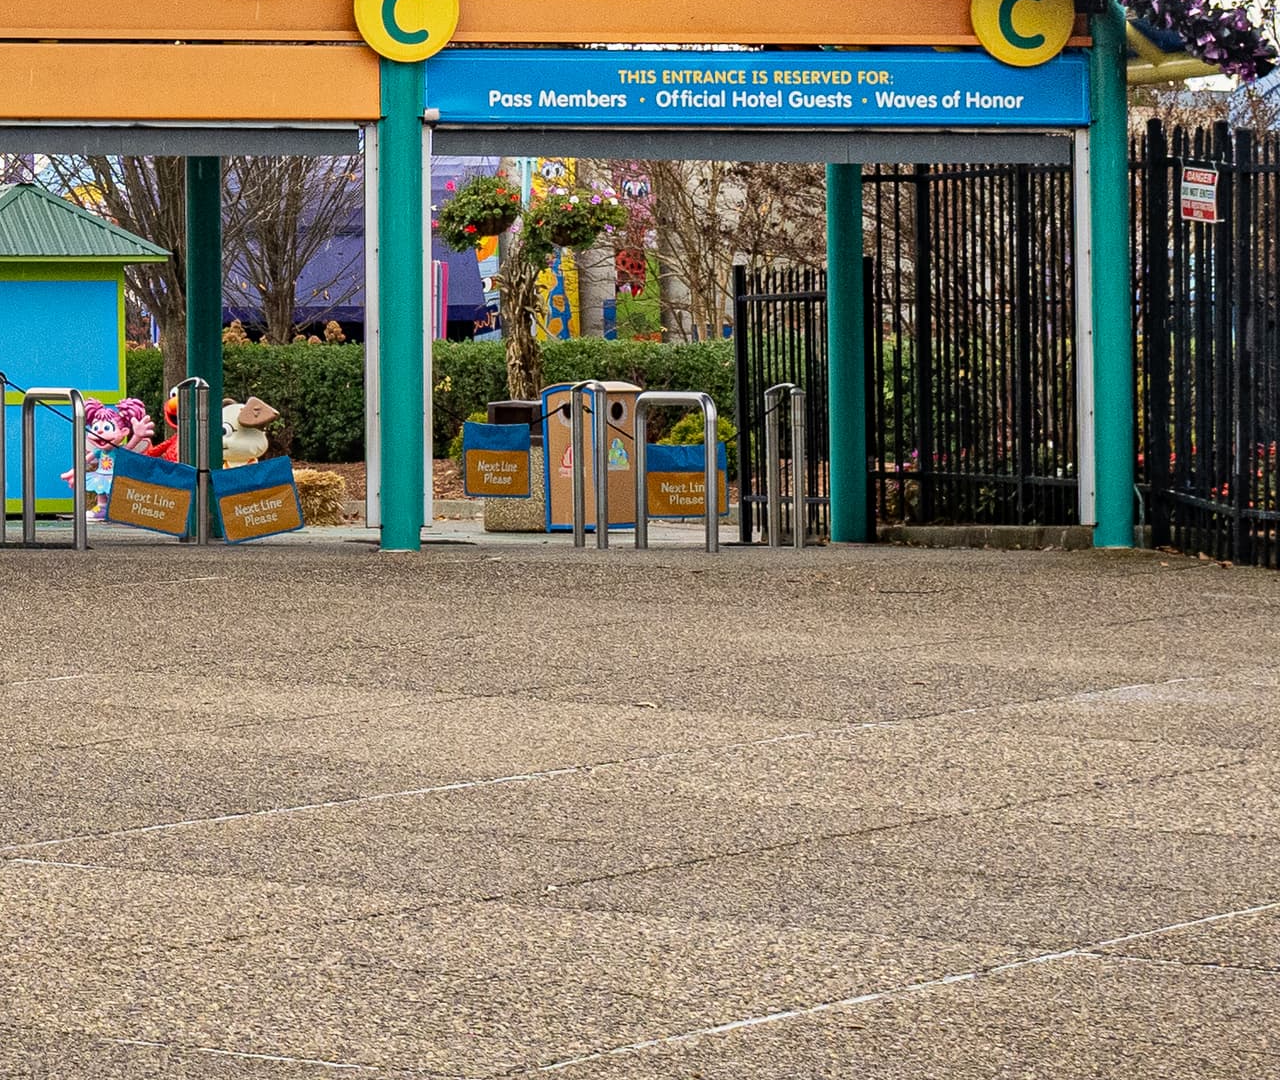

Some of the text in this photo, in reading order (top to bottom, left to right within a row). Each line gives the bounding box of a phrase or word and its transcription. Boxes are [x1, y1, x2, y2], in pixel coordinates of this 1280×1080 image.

[618, 69, 894, 85] THIS ENTRANCE IS RESERVED FOR:
[489, 89, 1024, 109] Pass Members Official Hotel Guests Waves of Honor
[476, 460, 518, 473] Next Line
[483, 473, 512, 485] Please
[661, 482, 705, 493] Next Lin
[126, 488, 176, 509] Next Line
[131, 502, 166, 520] Please
[234, 497, 283, 518] Next Line
[244, 511, 278, 527] Please
